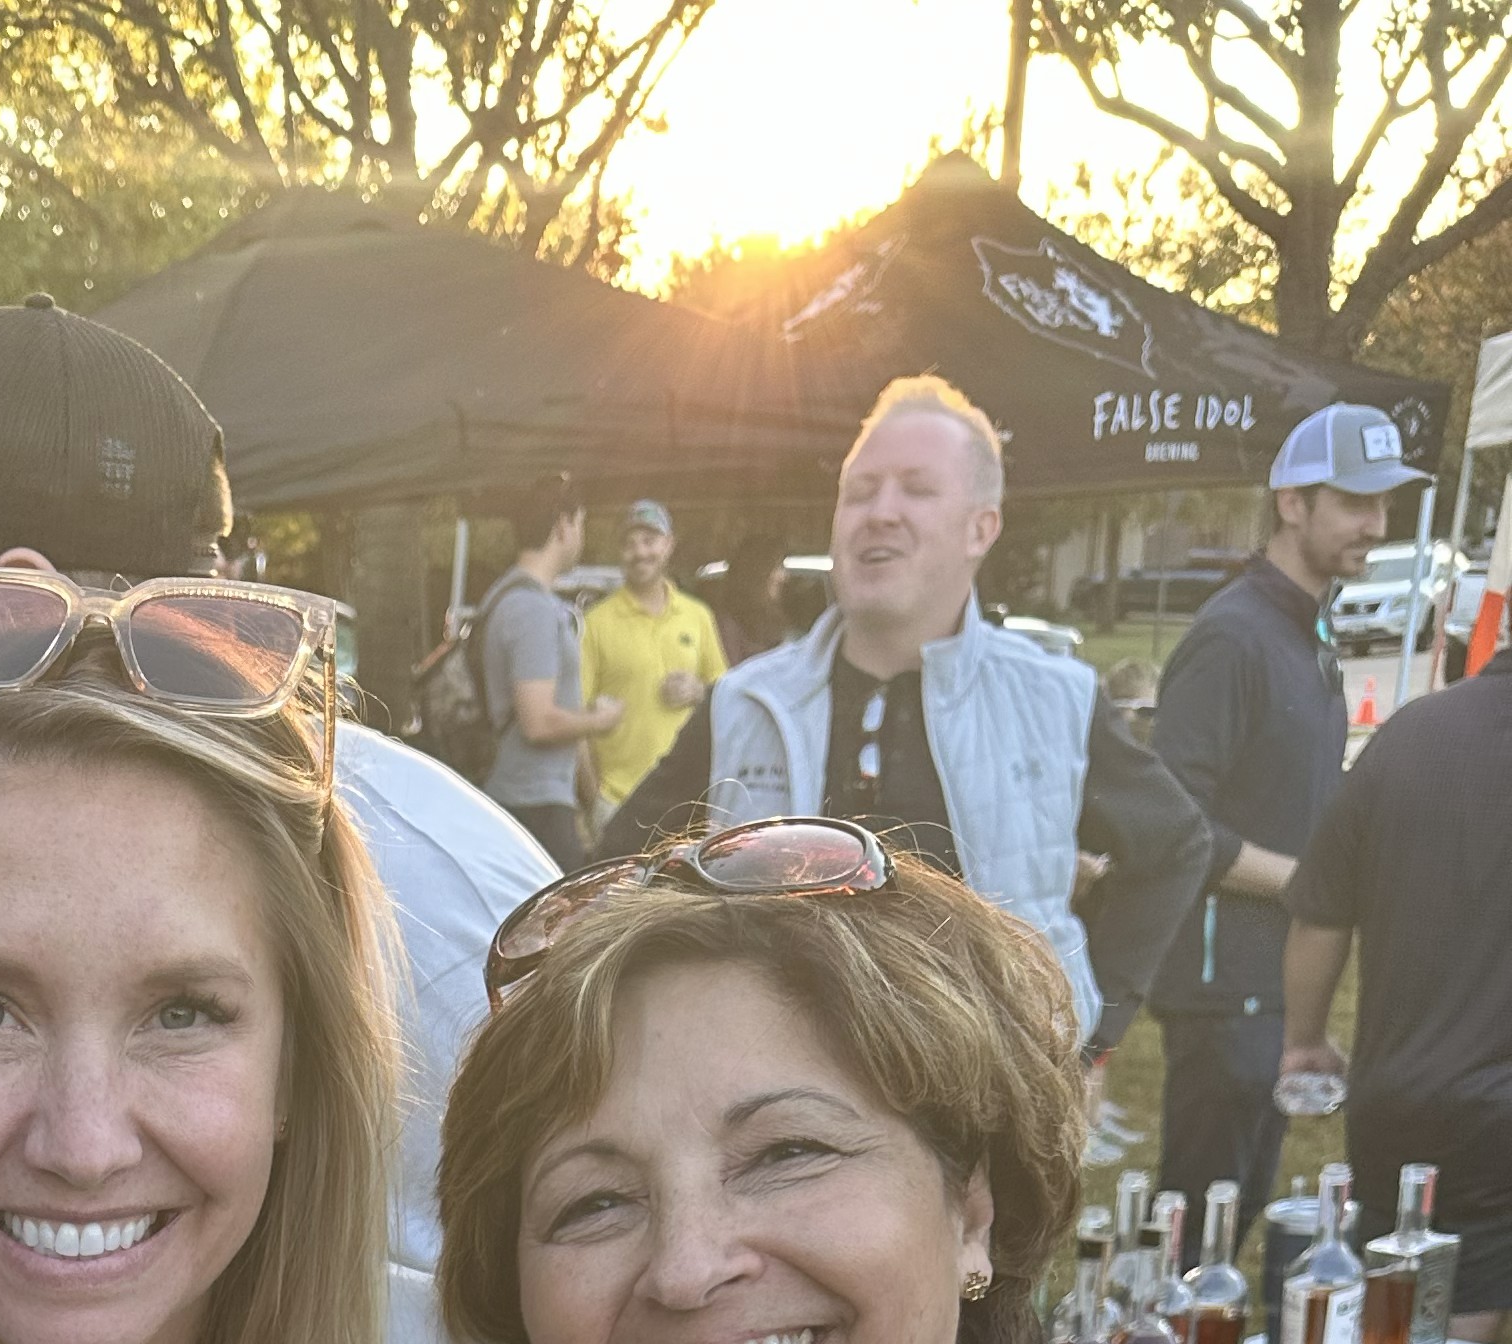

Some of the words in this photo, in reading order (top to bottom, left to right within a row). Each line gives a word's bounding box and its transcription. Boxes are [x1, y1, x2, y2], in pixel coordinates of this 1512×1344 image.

[1092, 390, 1182, 440] FALSE
[1194, 394, 1257, 431] IDOL
[1144, 442, 1200, 463] BREWING
